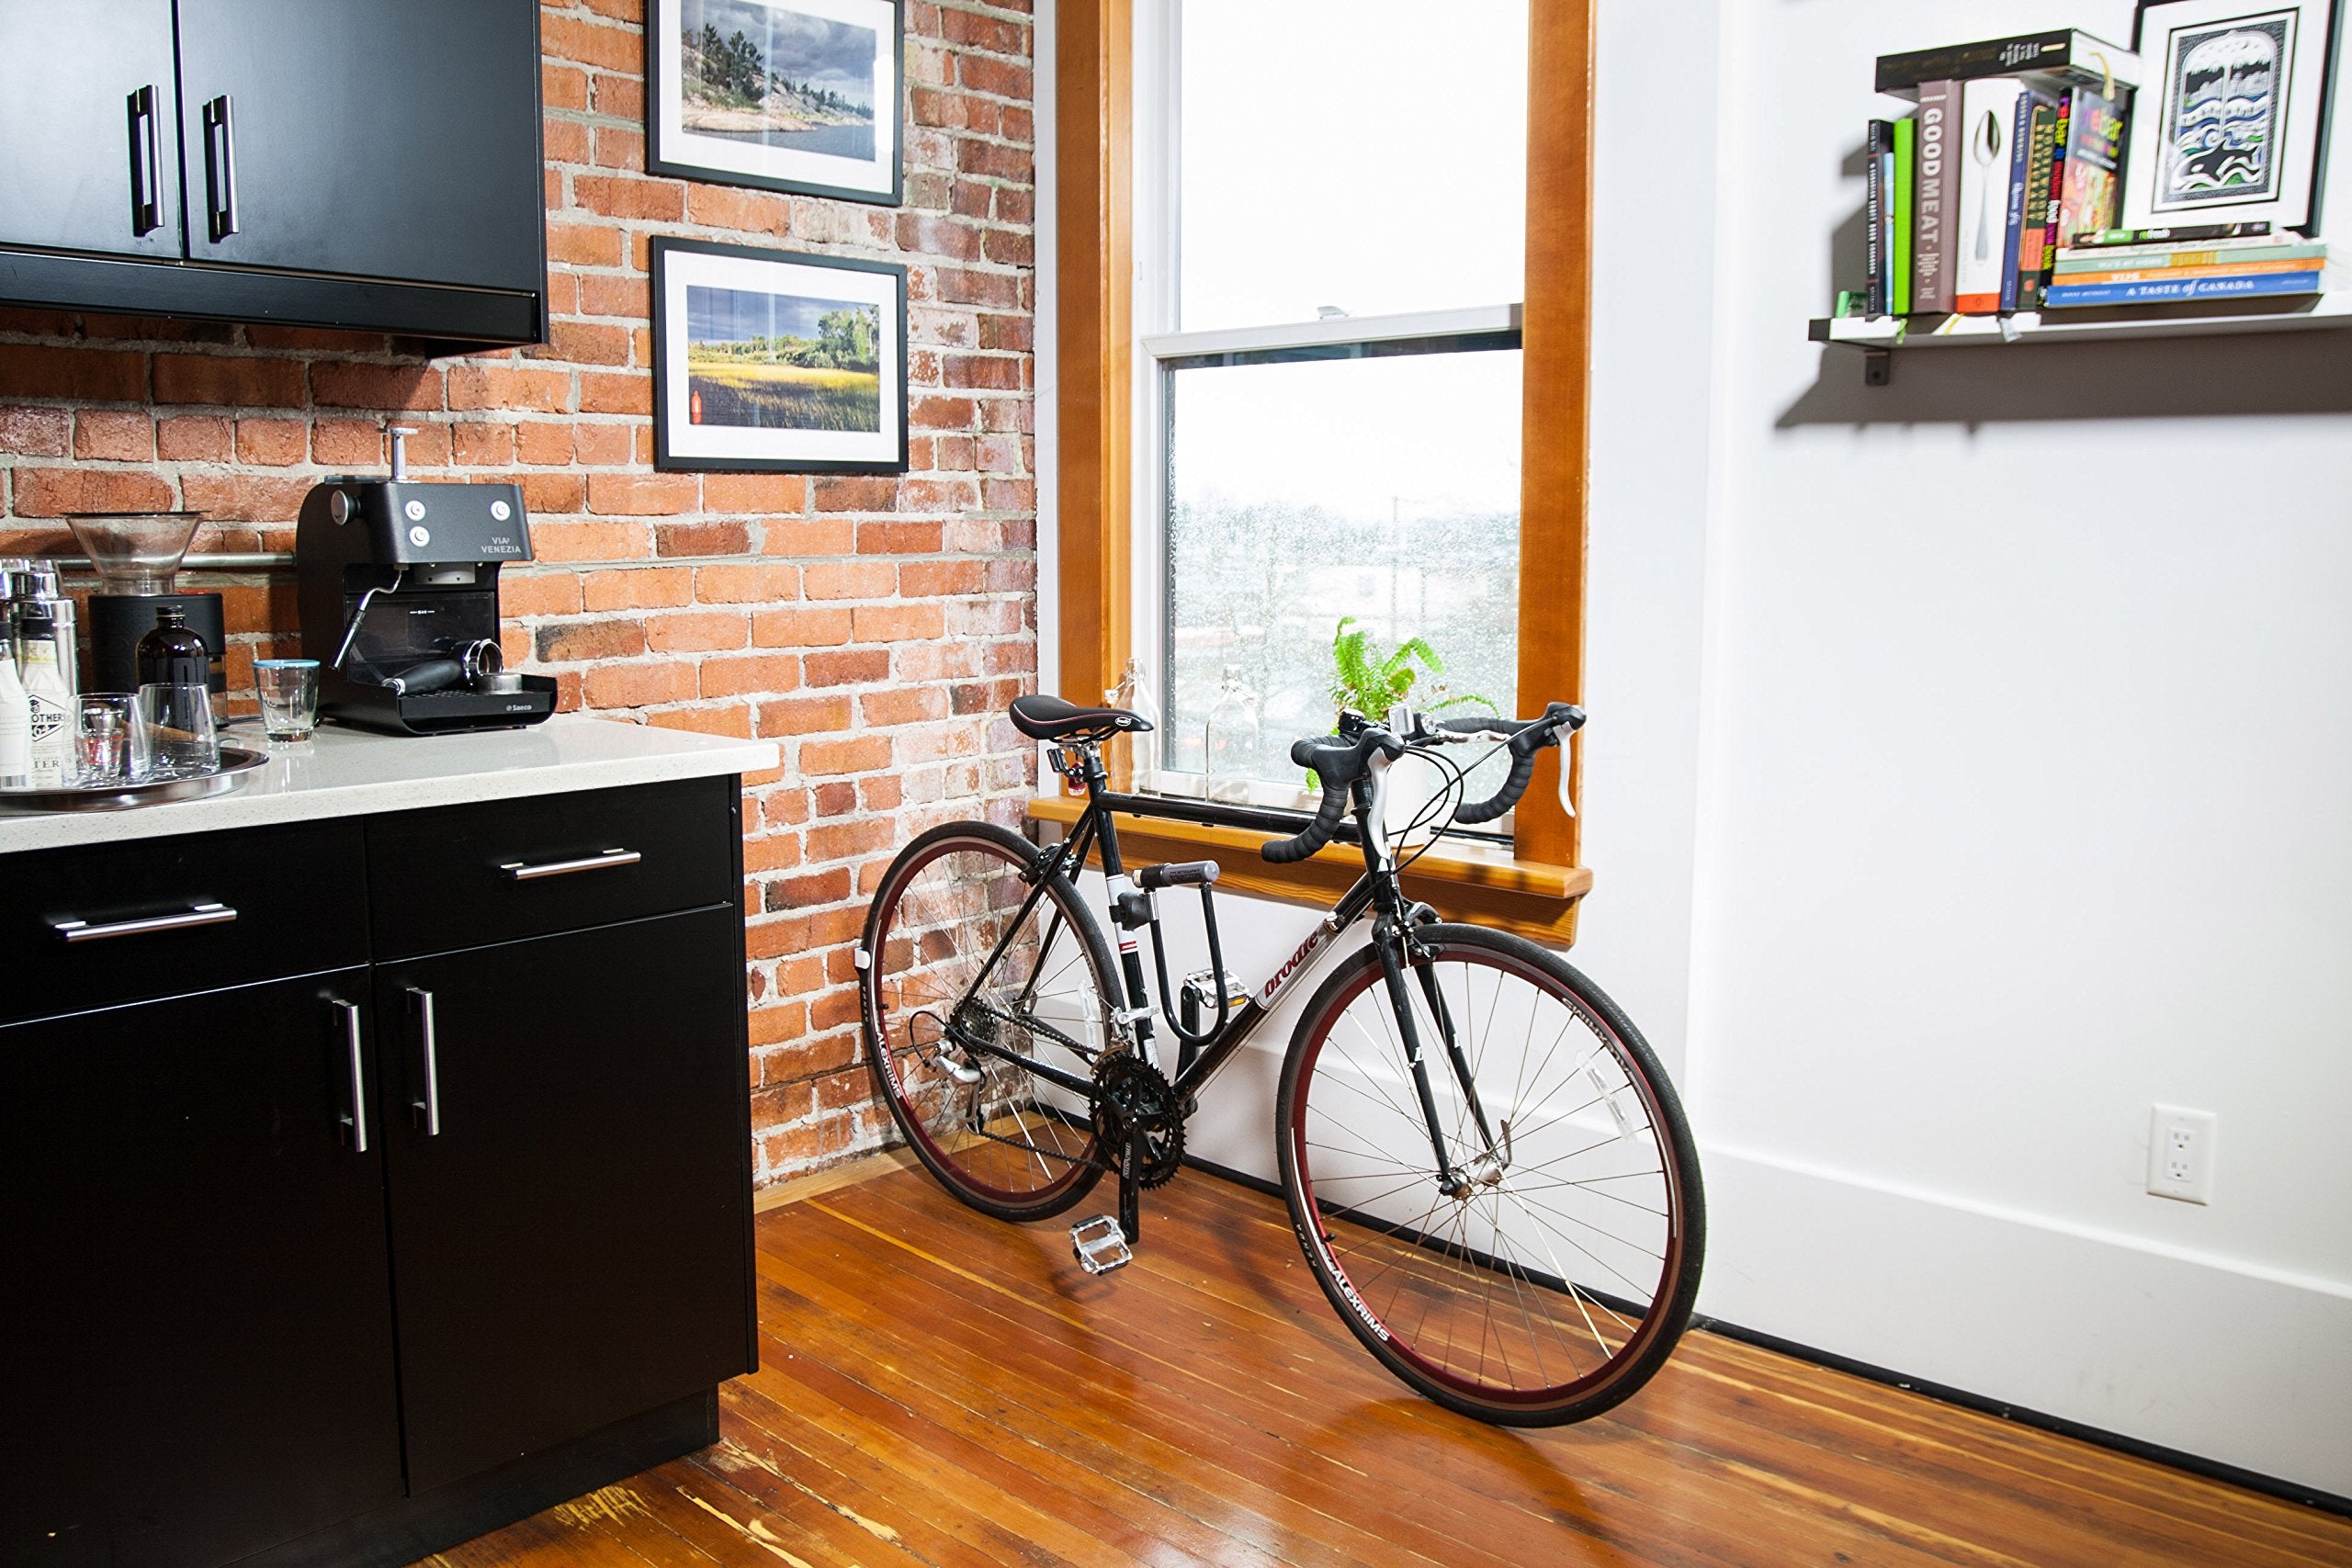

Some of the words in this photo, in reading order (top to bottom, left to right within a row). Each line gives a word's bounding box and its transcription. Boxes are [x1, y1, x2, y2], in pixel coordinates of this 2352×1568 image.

[2037, 123, 2055, 220] MOOSEWOOD
[2046, 199, 2061, 223] food
[2125, 288, 2136, 297] A
[2140, 284, 2180, 295] TASTE
[2182, 279, 2199, 297] of
[2199, 280, 2255, 293] CANADA
[481, 545, 521, 554] VENEZIA
[512, 704, 532, 712] Saeco
[1263, 930, 1319, 998] brodie
[876, 1032, 903, 1100] ALEXRIMS
[1295, 1223, 1317, 1268] KENDA
[1331, 1269, 1391, 1341] ALEXRIMS
